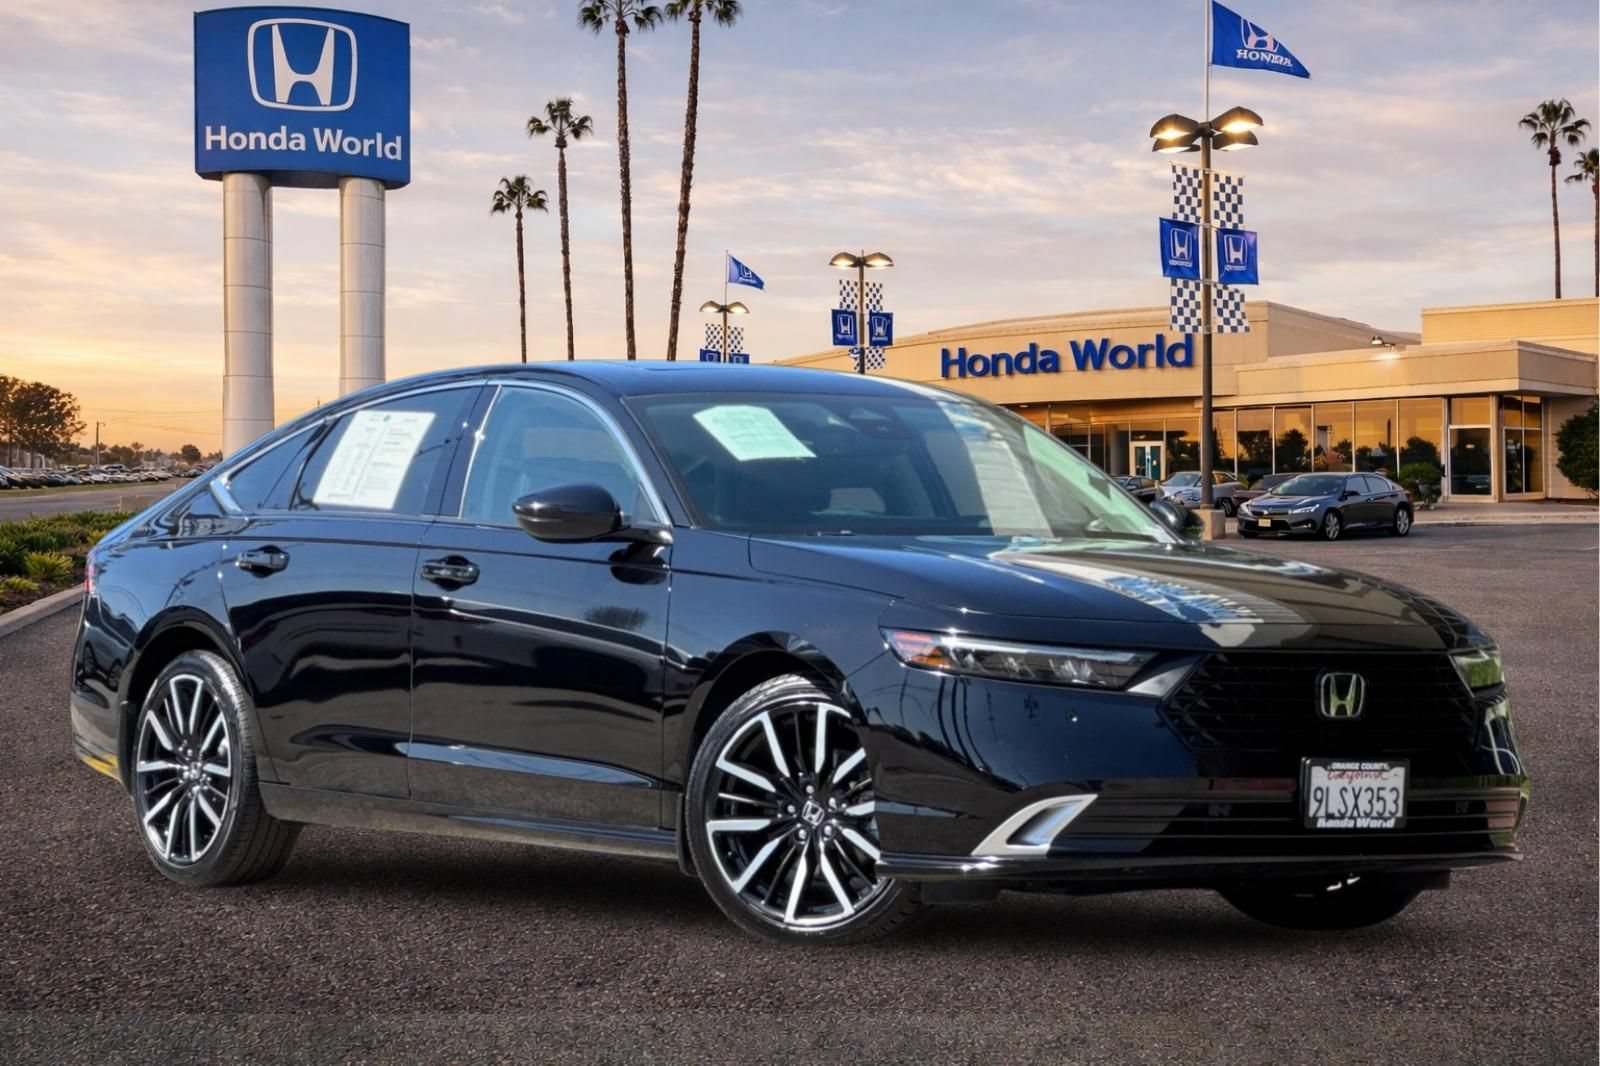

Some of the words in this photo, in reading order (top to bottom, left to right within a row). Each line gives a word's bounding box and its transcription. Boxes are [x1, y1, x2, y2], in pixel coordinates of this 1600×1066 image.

[205, 125, 306, 151] Honda
[313, 127, 402, 161] World
[941, 342, 1060, 379] Honda
[1070, 333, 1194, 372] World
[1312, 786, 1400, 818] 9LSX353
